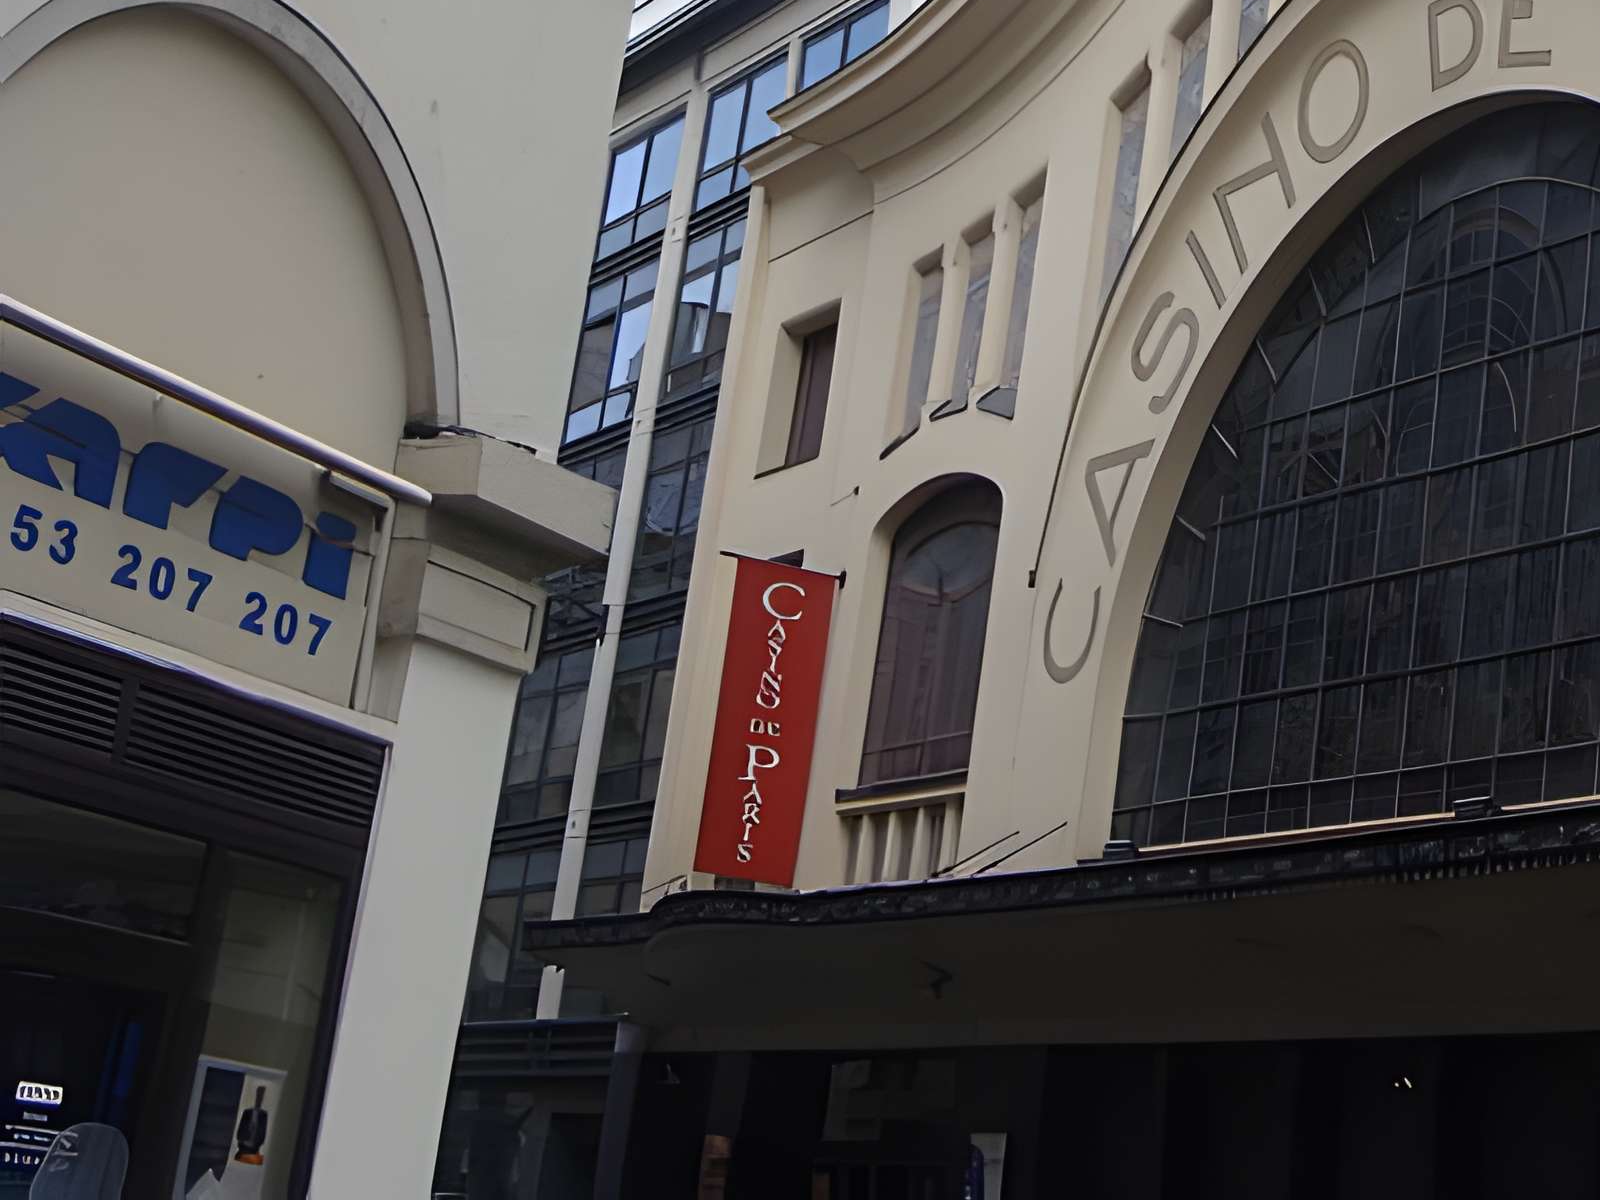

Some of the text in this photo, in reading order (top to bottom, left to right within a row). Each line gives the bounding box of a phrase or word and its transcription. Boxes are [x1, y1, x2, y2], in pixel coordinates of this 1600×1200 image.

[1043, 37, 1369, 684] CASINO
[10, 504, 332, 656] 53 207 207
[736, 744, 780, 863] PARIS
